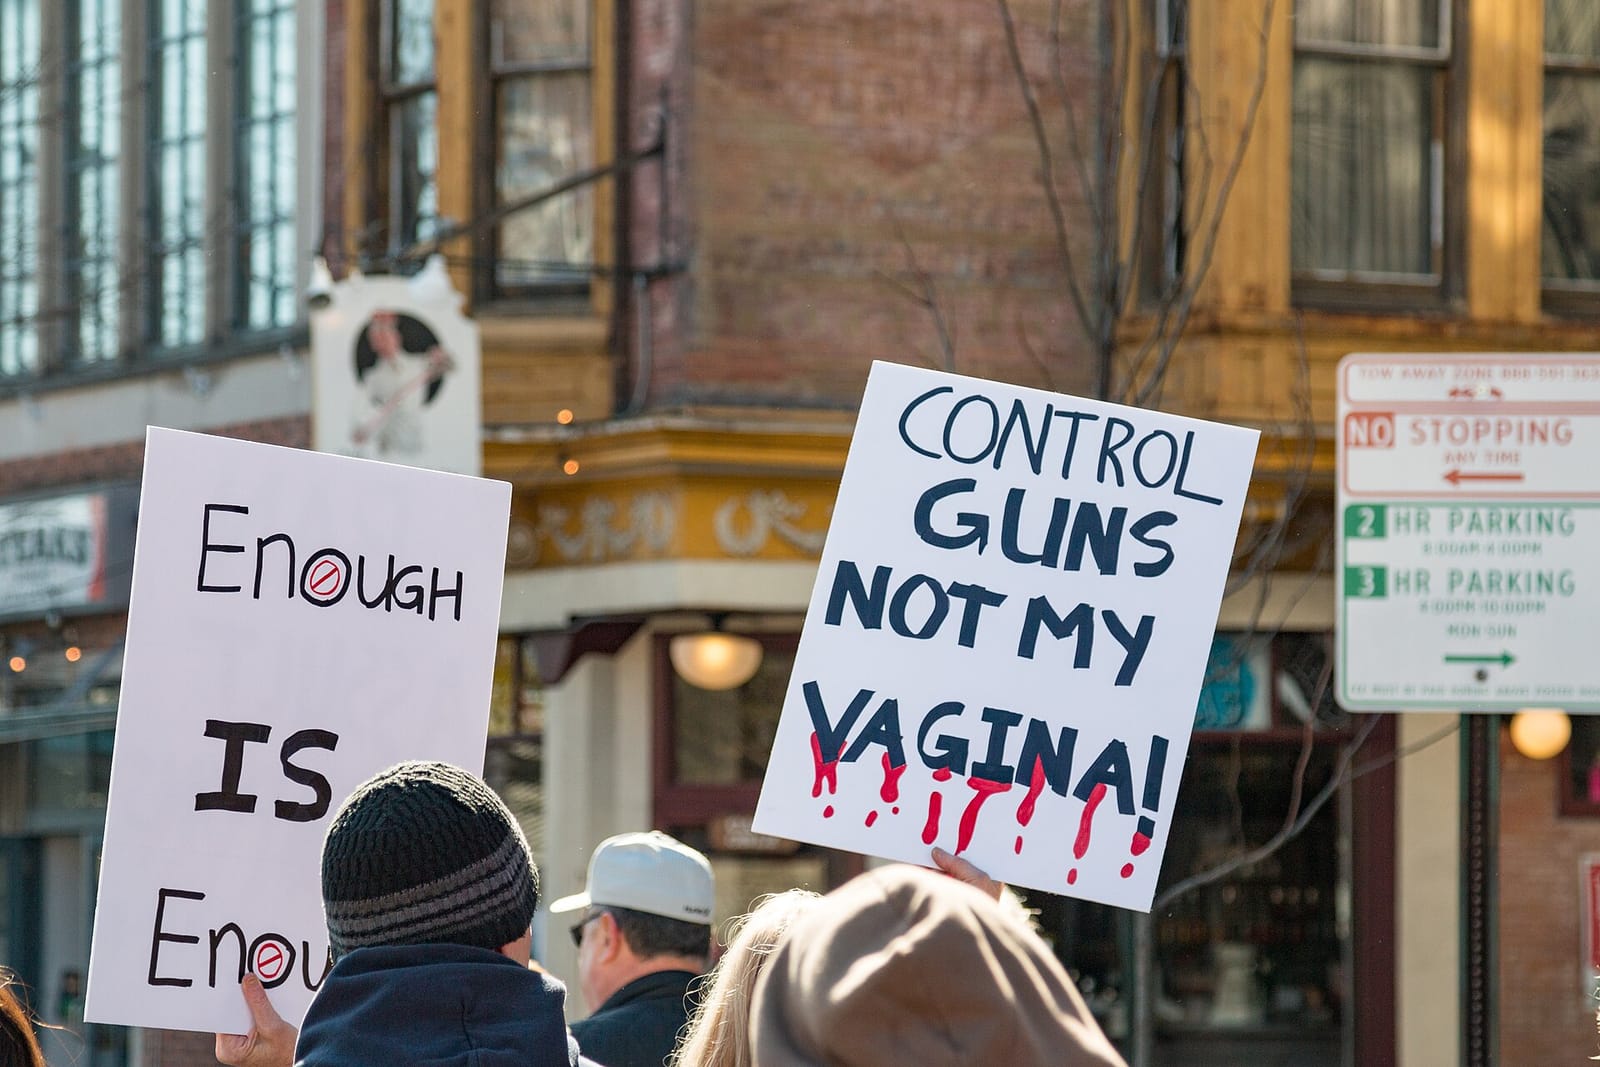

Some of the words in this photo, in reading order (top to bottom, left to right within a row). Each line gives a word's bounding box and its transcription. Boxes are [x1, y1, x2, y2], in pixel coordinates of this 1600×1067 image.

[899, 386, 1223, 506] CONTROL
[1349, 417, 1392, 448] NO
[1410, 418, 1574, 445] STOPPING
[1485, 451, 1521, 465] TIME
[913, 478, 1178, 578] GUNS
[1357, 507, 1375, 537] 2
[1394, 509, 1431, 534] HR
[1449, 509, 1576, 537] PARKING
[825, 560, 1008, 648] NOT
[1017, 595, 1156, 686] MY
[1357, 567, 1375, 597] 3
[1394, 569, 1431, 594] HR
[1449, 569, 1576, 597] PARKING
[194, 718, 339, 822] IS
[802, 681, 1170, 838] VAGINA!
[147, 888, 334, 992] Enou
